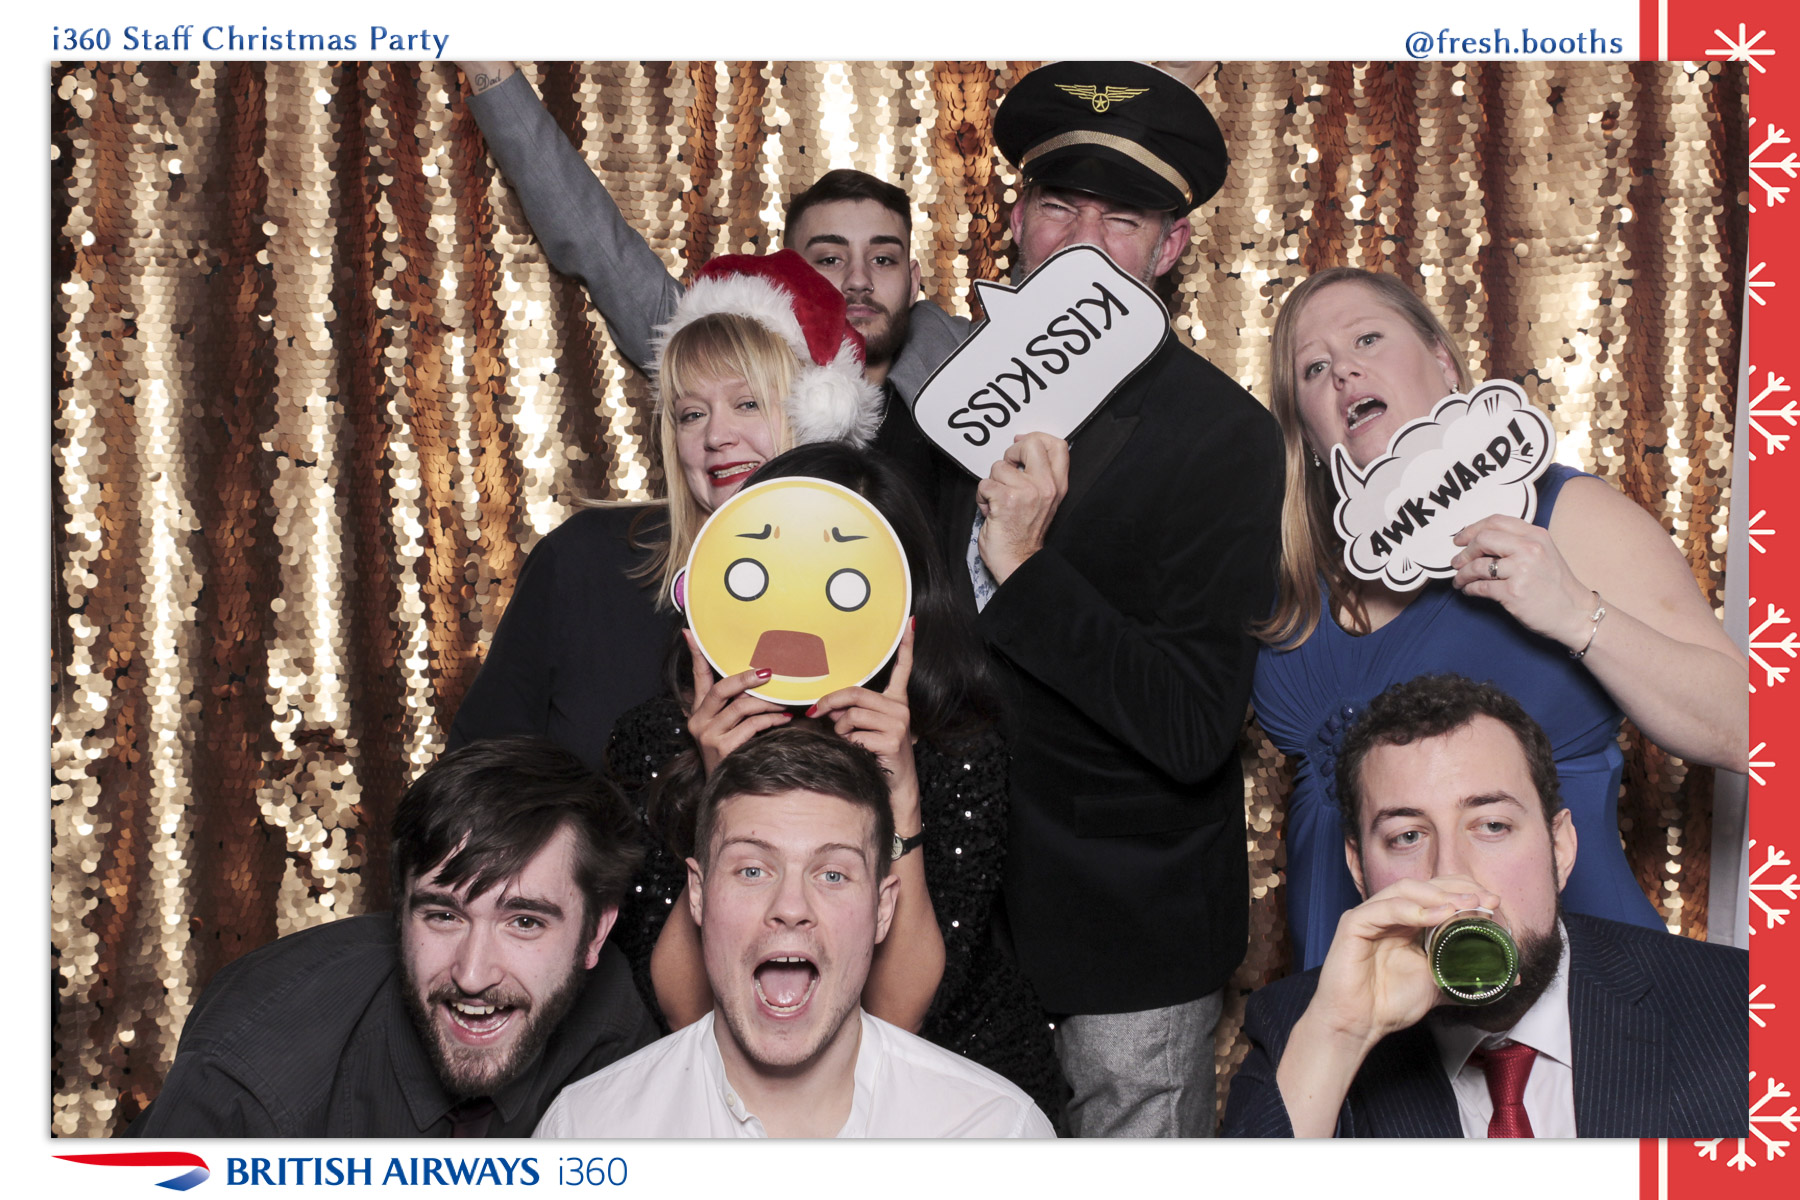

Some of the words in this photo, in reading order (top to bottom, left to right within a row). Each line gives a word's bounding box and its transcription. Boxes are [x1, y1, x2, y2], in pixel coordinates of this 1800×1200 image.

[1025, 282, 1129, 374] KISS
[948, 357, 1047, 446] KISS
[1370, 417, 1534, 557] AWKWARD!
